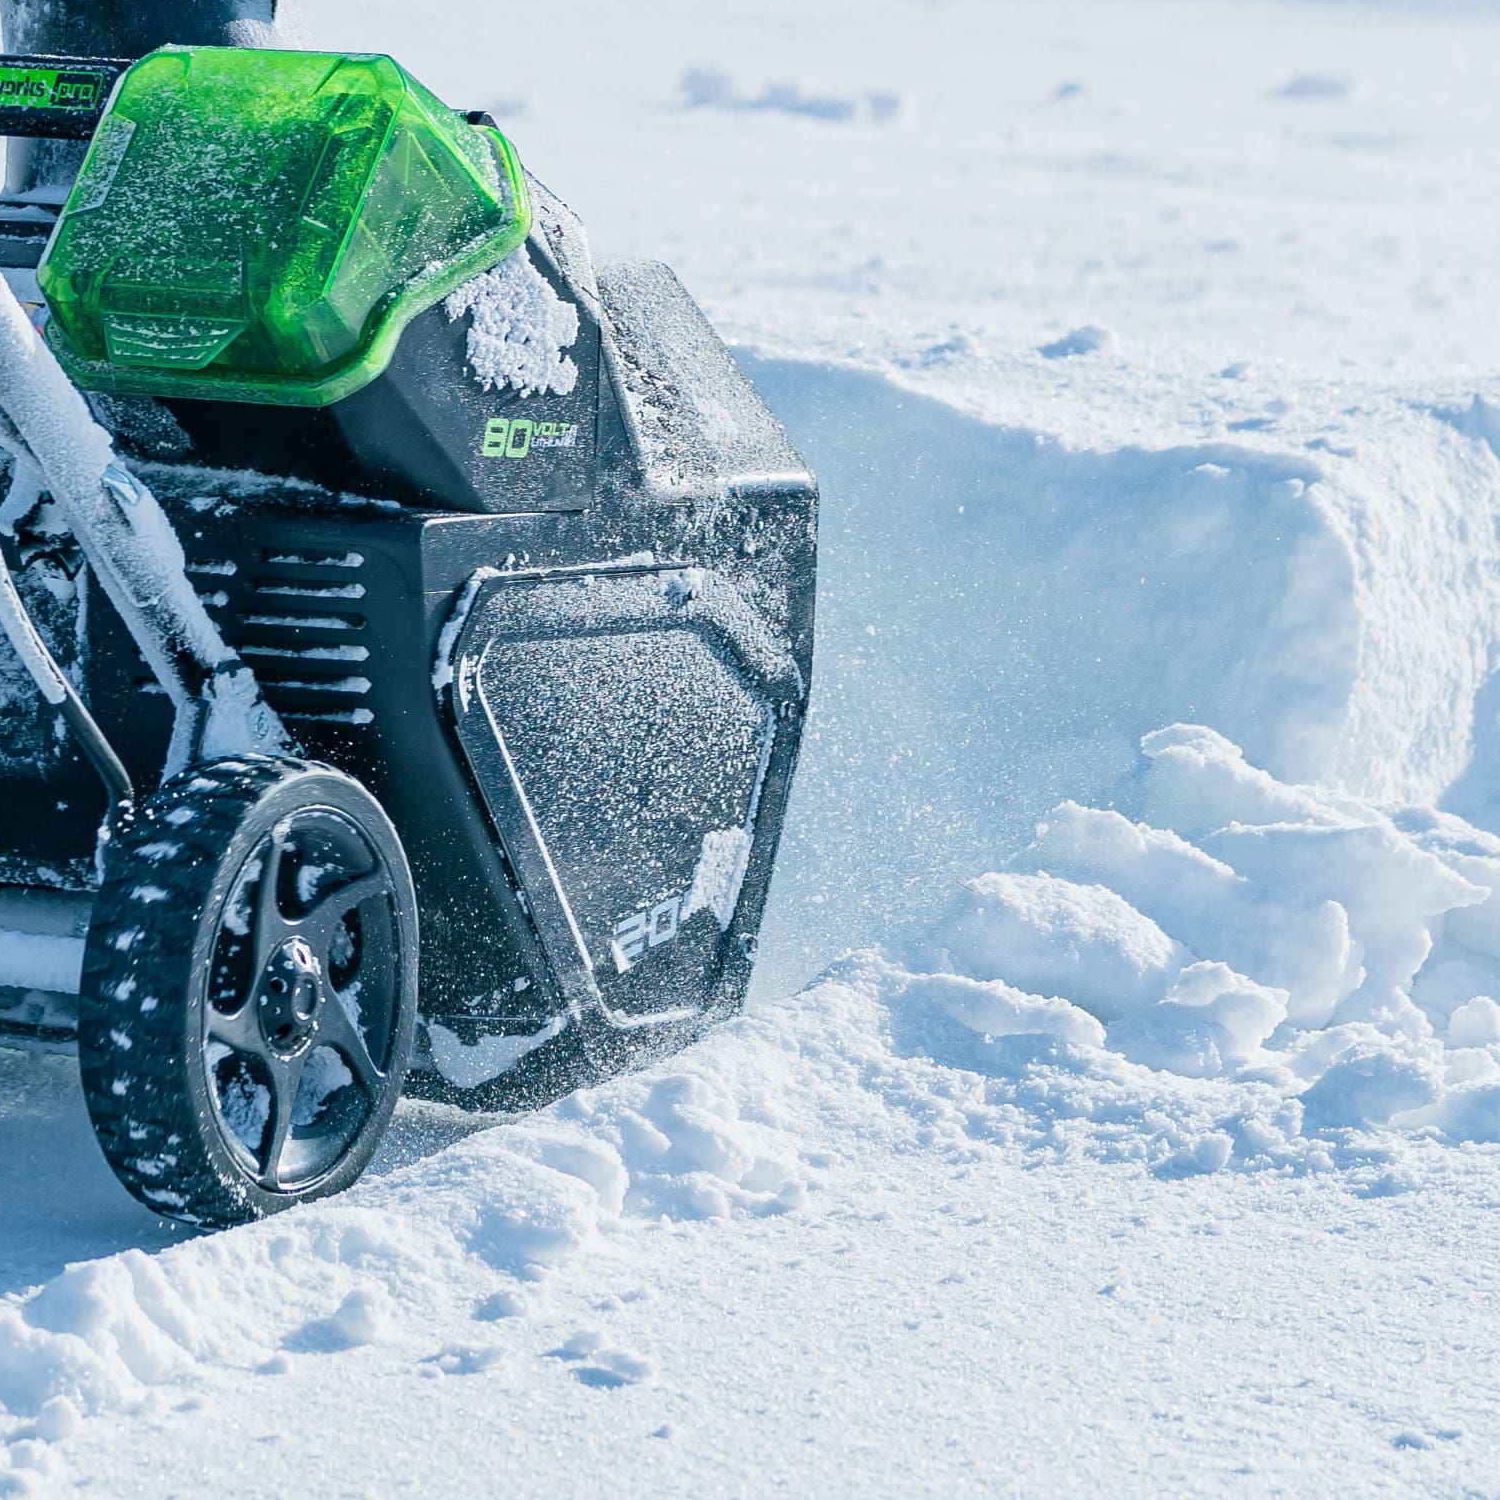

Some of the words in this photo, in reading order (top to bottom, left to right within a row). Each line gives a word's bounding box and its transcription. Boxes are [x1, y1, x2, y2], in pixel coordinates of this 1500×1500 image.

[55, 82, 94, 100] pro
[482, 417, 534, 458] 80
[533, 421, 571, 437] VOLT
